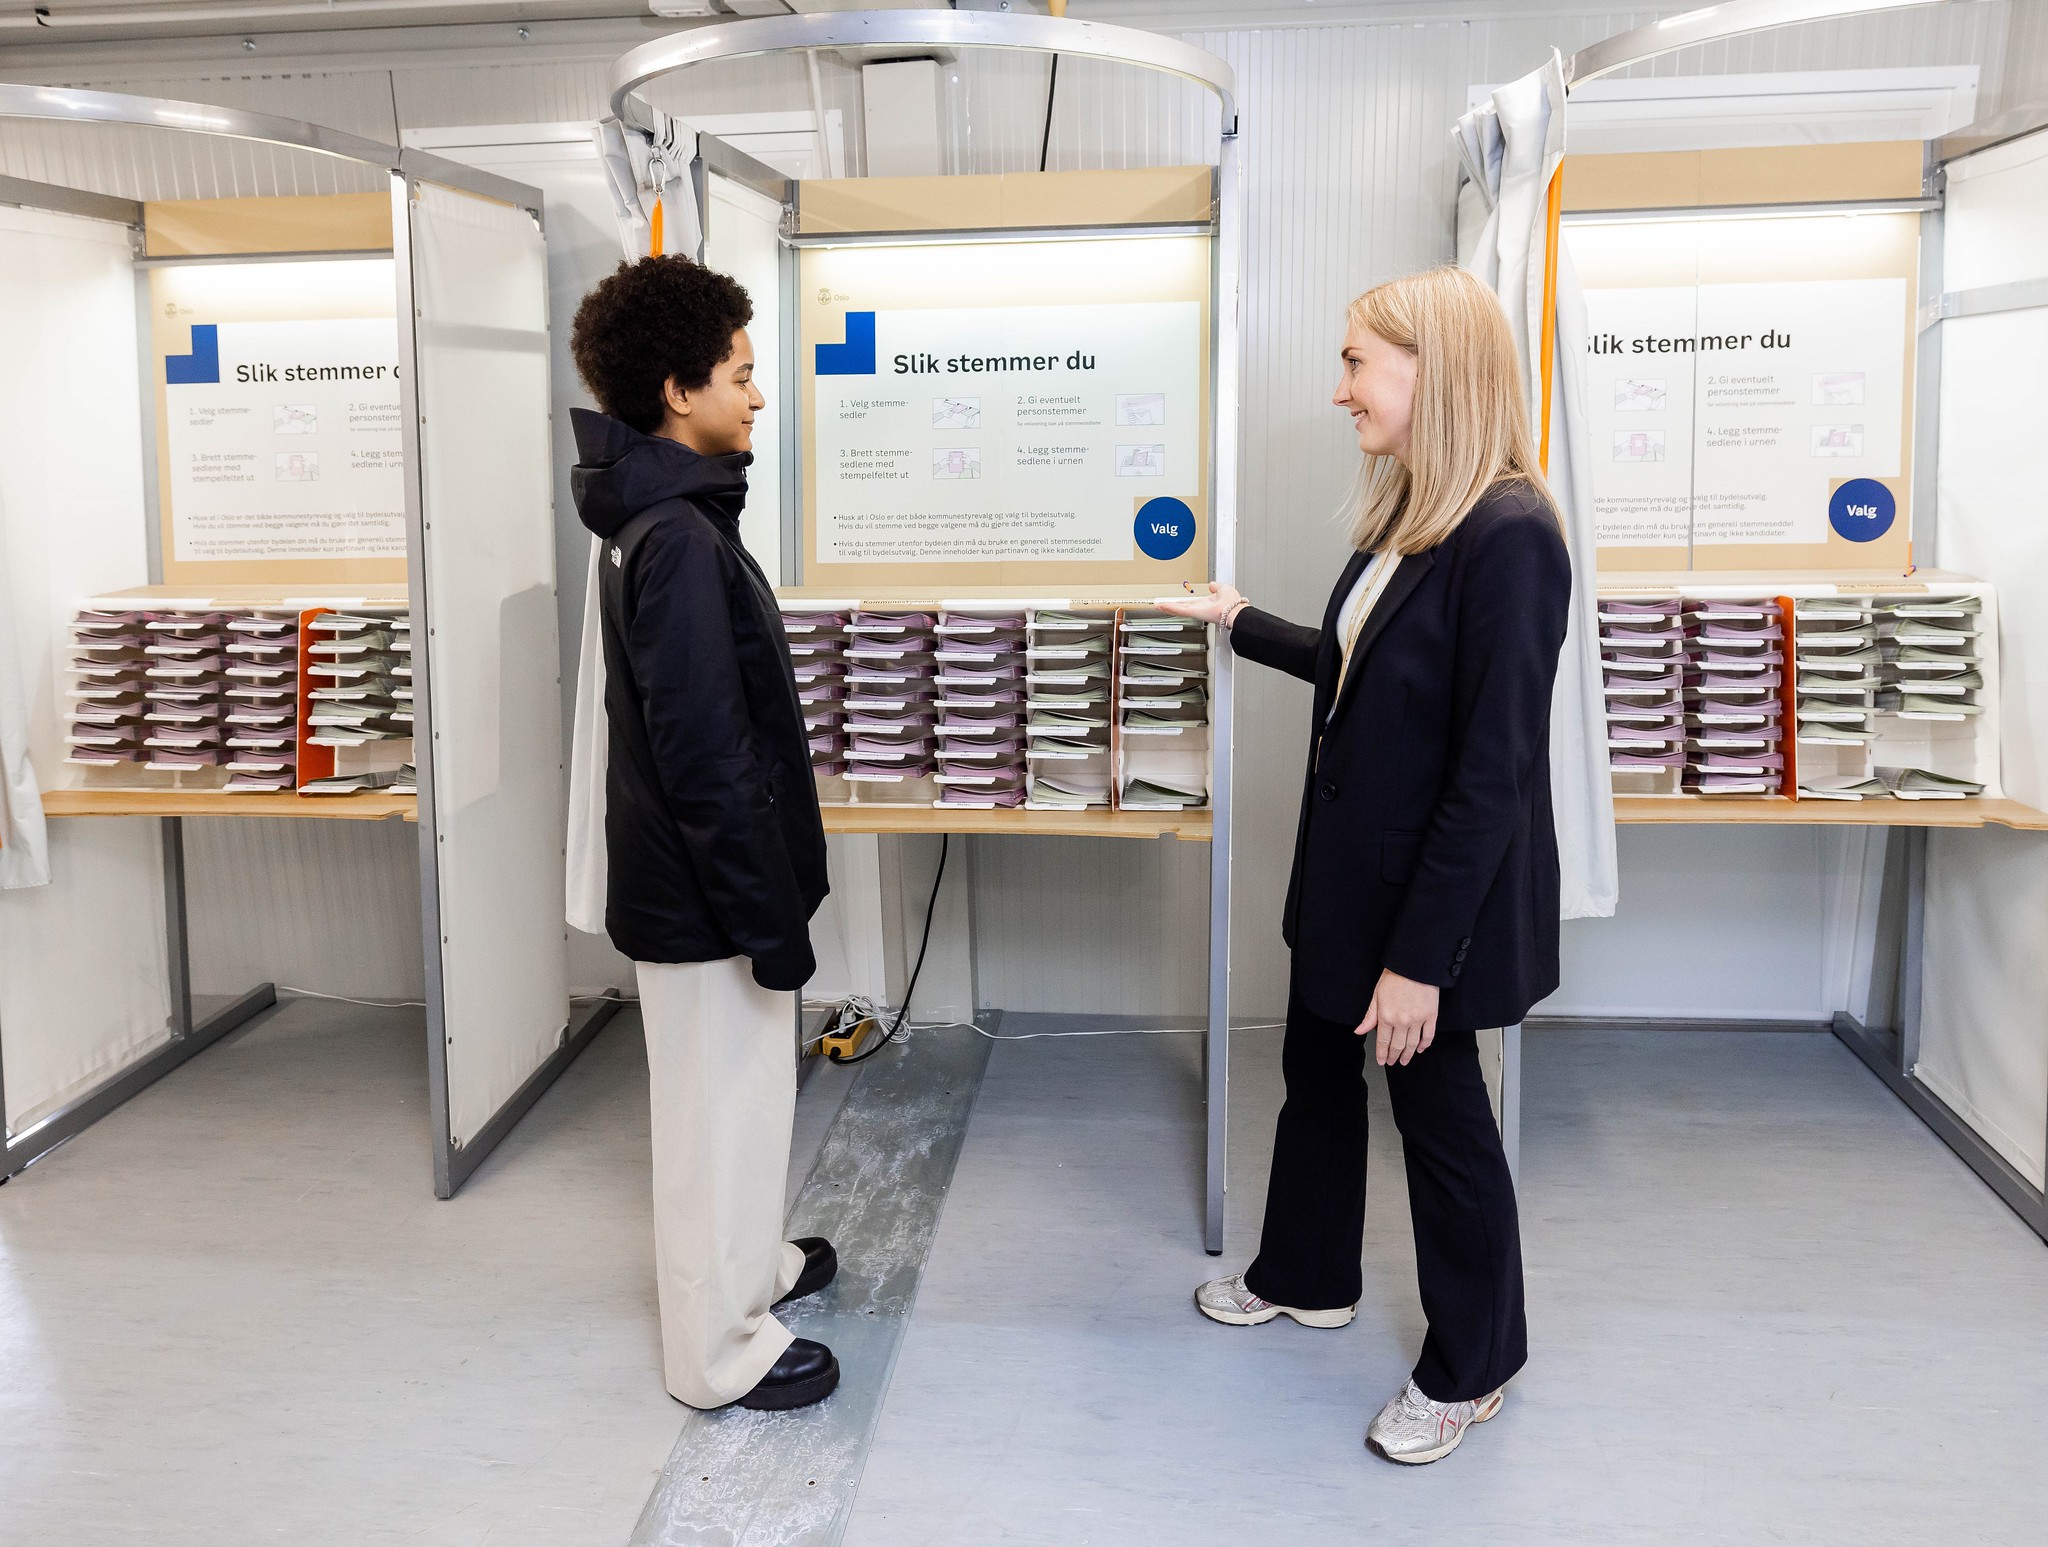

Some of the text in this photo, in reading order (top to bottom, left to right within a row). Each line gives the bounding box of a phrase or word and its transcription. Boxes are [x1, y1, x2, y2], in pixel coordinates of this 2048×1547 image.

[1588, 329, 1791, 354] lik stemmer du
[894, 350, 1096, 374] Slik stemmer du
[236, 364, 278, 382] Slik
[285, 364, 386, 381] stemmer
[840, 399, 908, 410] 1. Velg stemme-
[1017, 395, 1081, 405] 2. Gi eventuelt
[840, 410, 867, 419] sedler
[1017, 407, 1087, 418] personstemmer
[840, 448, 912, 458] 3. Brett stemme-
[1017, 445, 1089, 456] 4. Legg stemme-
[840, 460, 896, 469] sedlene med
[1017, 456, 1051, 466] sedlene
[840, 470, 909, 482] stempelfeltet ut
[1846, 504, 1877, 518] Valg
[928, 512, 993, 521] kommunestyrevalg
[1005, 512, 1020, 520] valg
[1030, 512, 1076, 520] bydelsutvalg.
[918, 522, 939, 530] begge
[940, 522, 967, 530] valgene
[991, 521, 1010, 530] gjøre
[1024, 521, 1056, 529] samtidig.
[1150, 522, 1178, 536] Valg
[924, 540, 952, 548] bydelen
[1020, 539, 1049, 547] generell
[848, 549, 862, 558] valg
[872, 549, 919, 557] bydelsutvalg.
[919, 548, 942, 556] Denne
[995, 548, 1029, 556] partinavn
